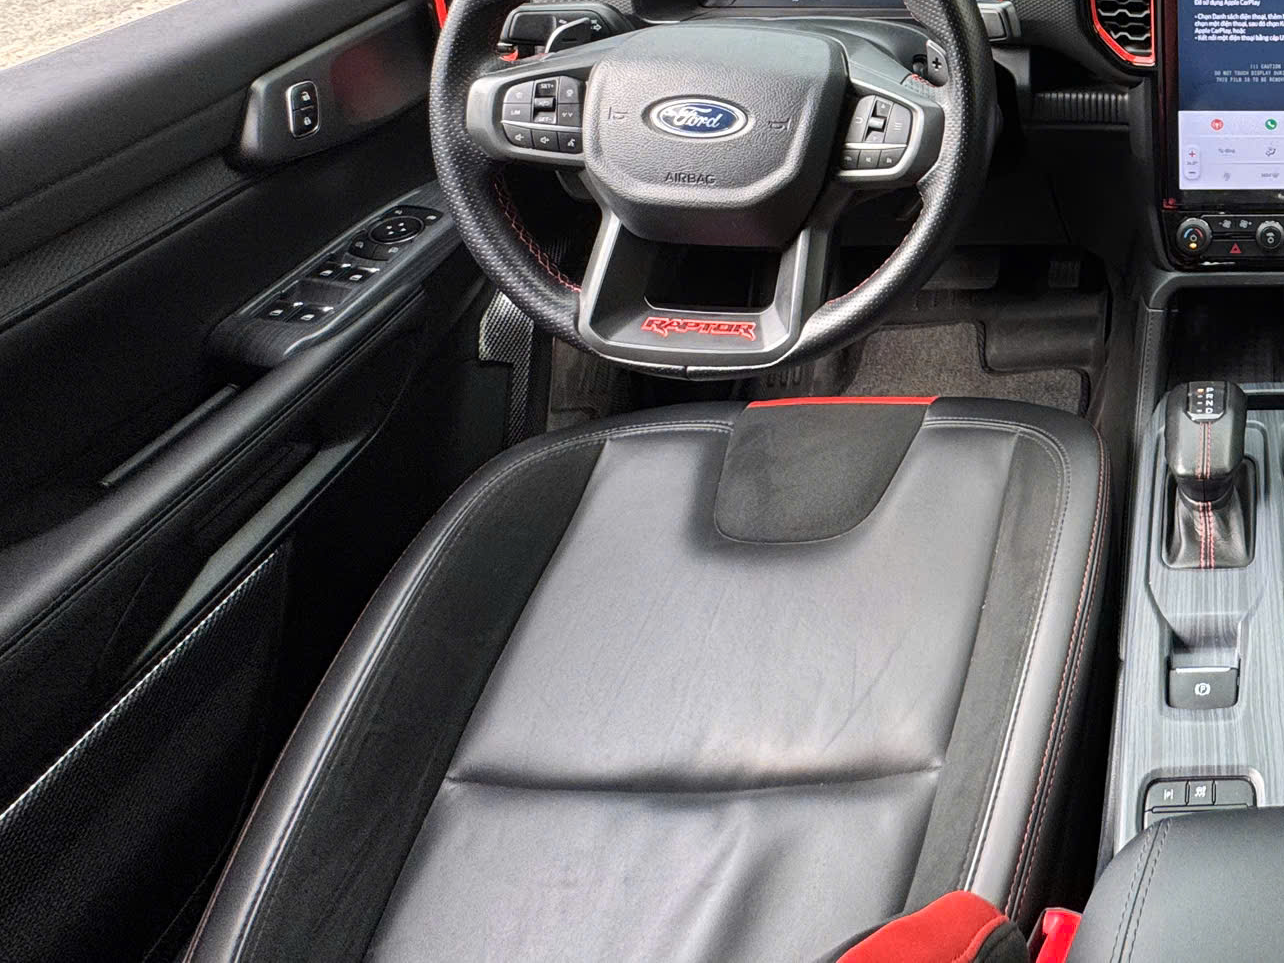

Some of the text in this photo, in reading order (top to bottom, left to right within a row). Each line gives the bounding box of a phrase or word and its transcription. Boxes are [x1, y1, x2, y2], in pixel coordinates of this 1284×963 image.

[662, 106, 723, 128] Ford
[665, 172, 717, 185] AIRBAG
[641, 317, 757, 341] RAPTOR
